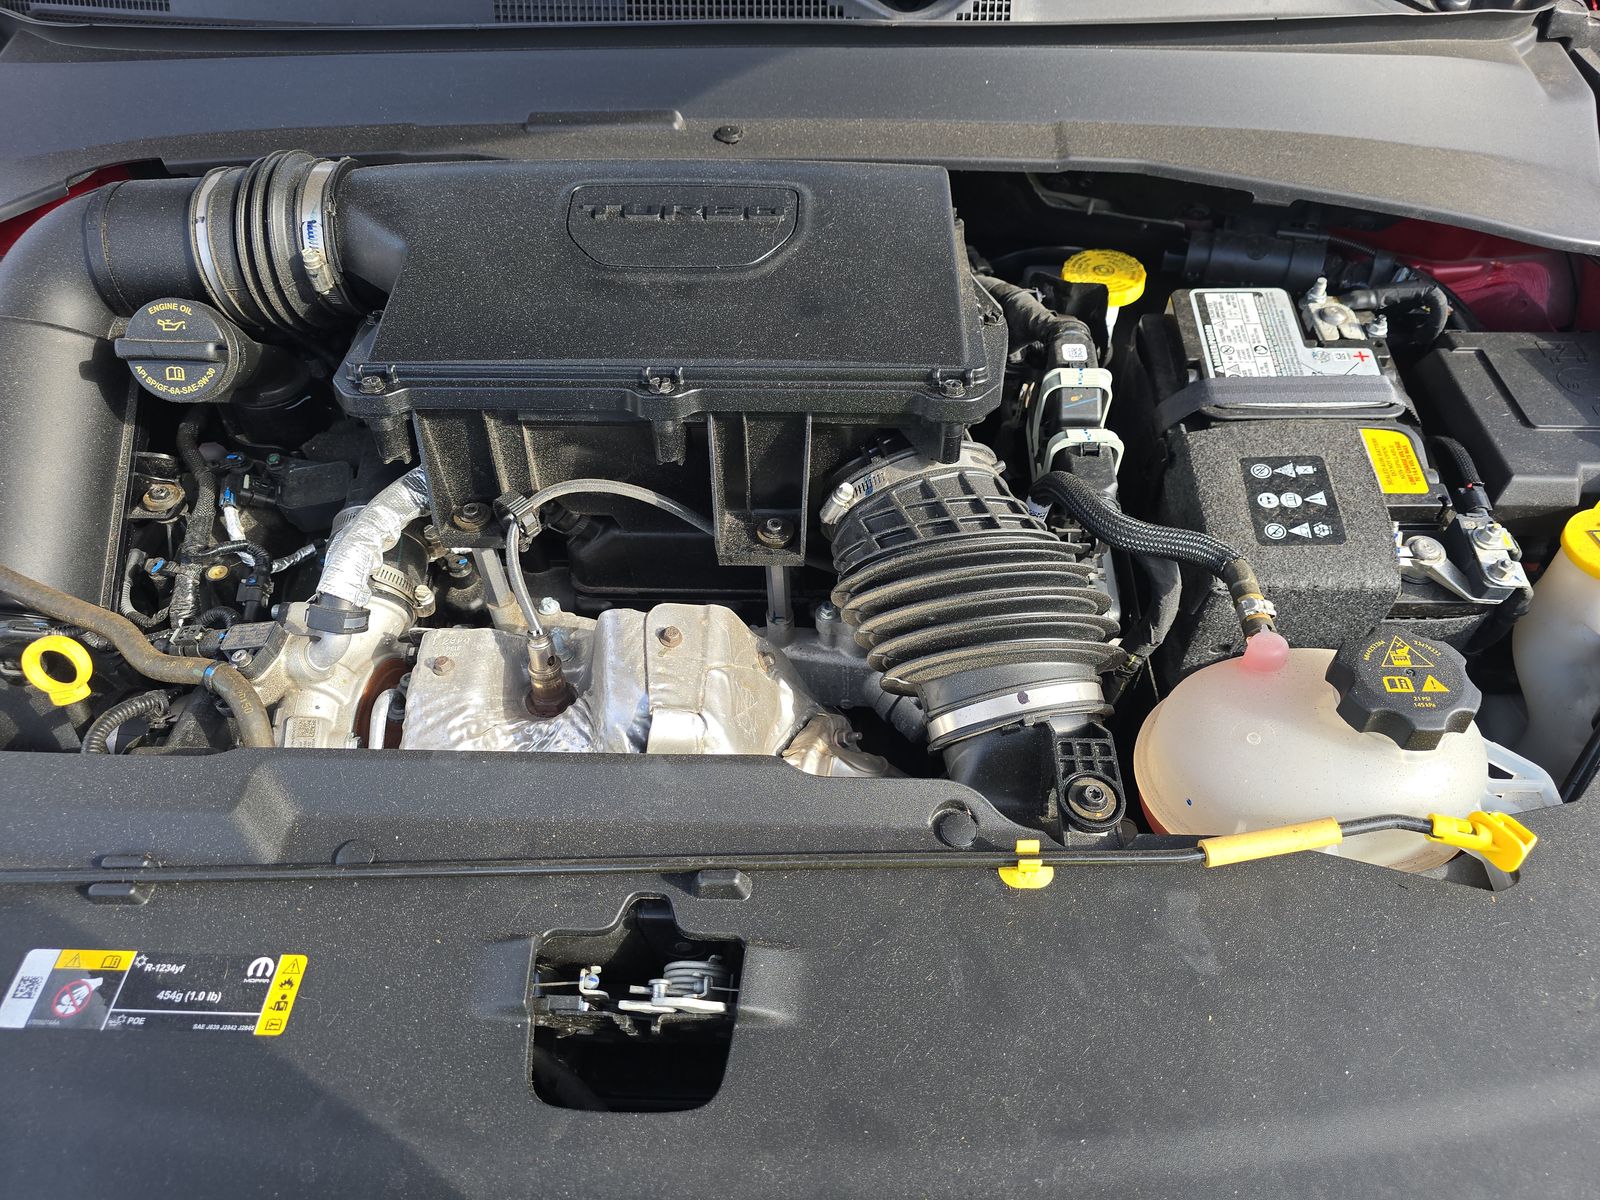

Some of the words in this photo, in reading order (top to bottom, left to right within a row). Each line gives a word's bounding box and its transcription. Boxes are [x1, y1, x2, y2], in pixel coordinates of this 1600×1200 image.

[148, 302, 179, 315] ENGINE
[180, 304, 193, 316] OIL
[135, 365, 147, 379] API
[144, 963, 186, 974] R-1234yf
[156, 990, 183, 1003] 454g
[184, 990, 205, 1003] (1.0
[206, 991, 222, 1003] lb)
[127, 1017, 146, 1025] POE
